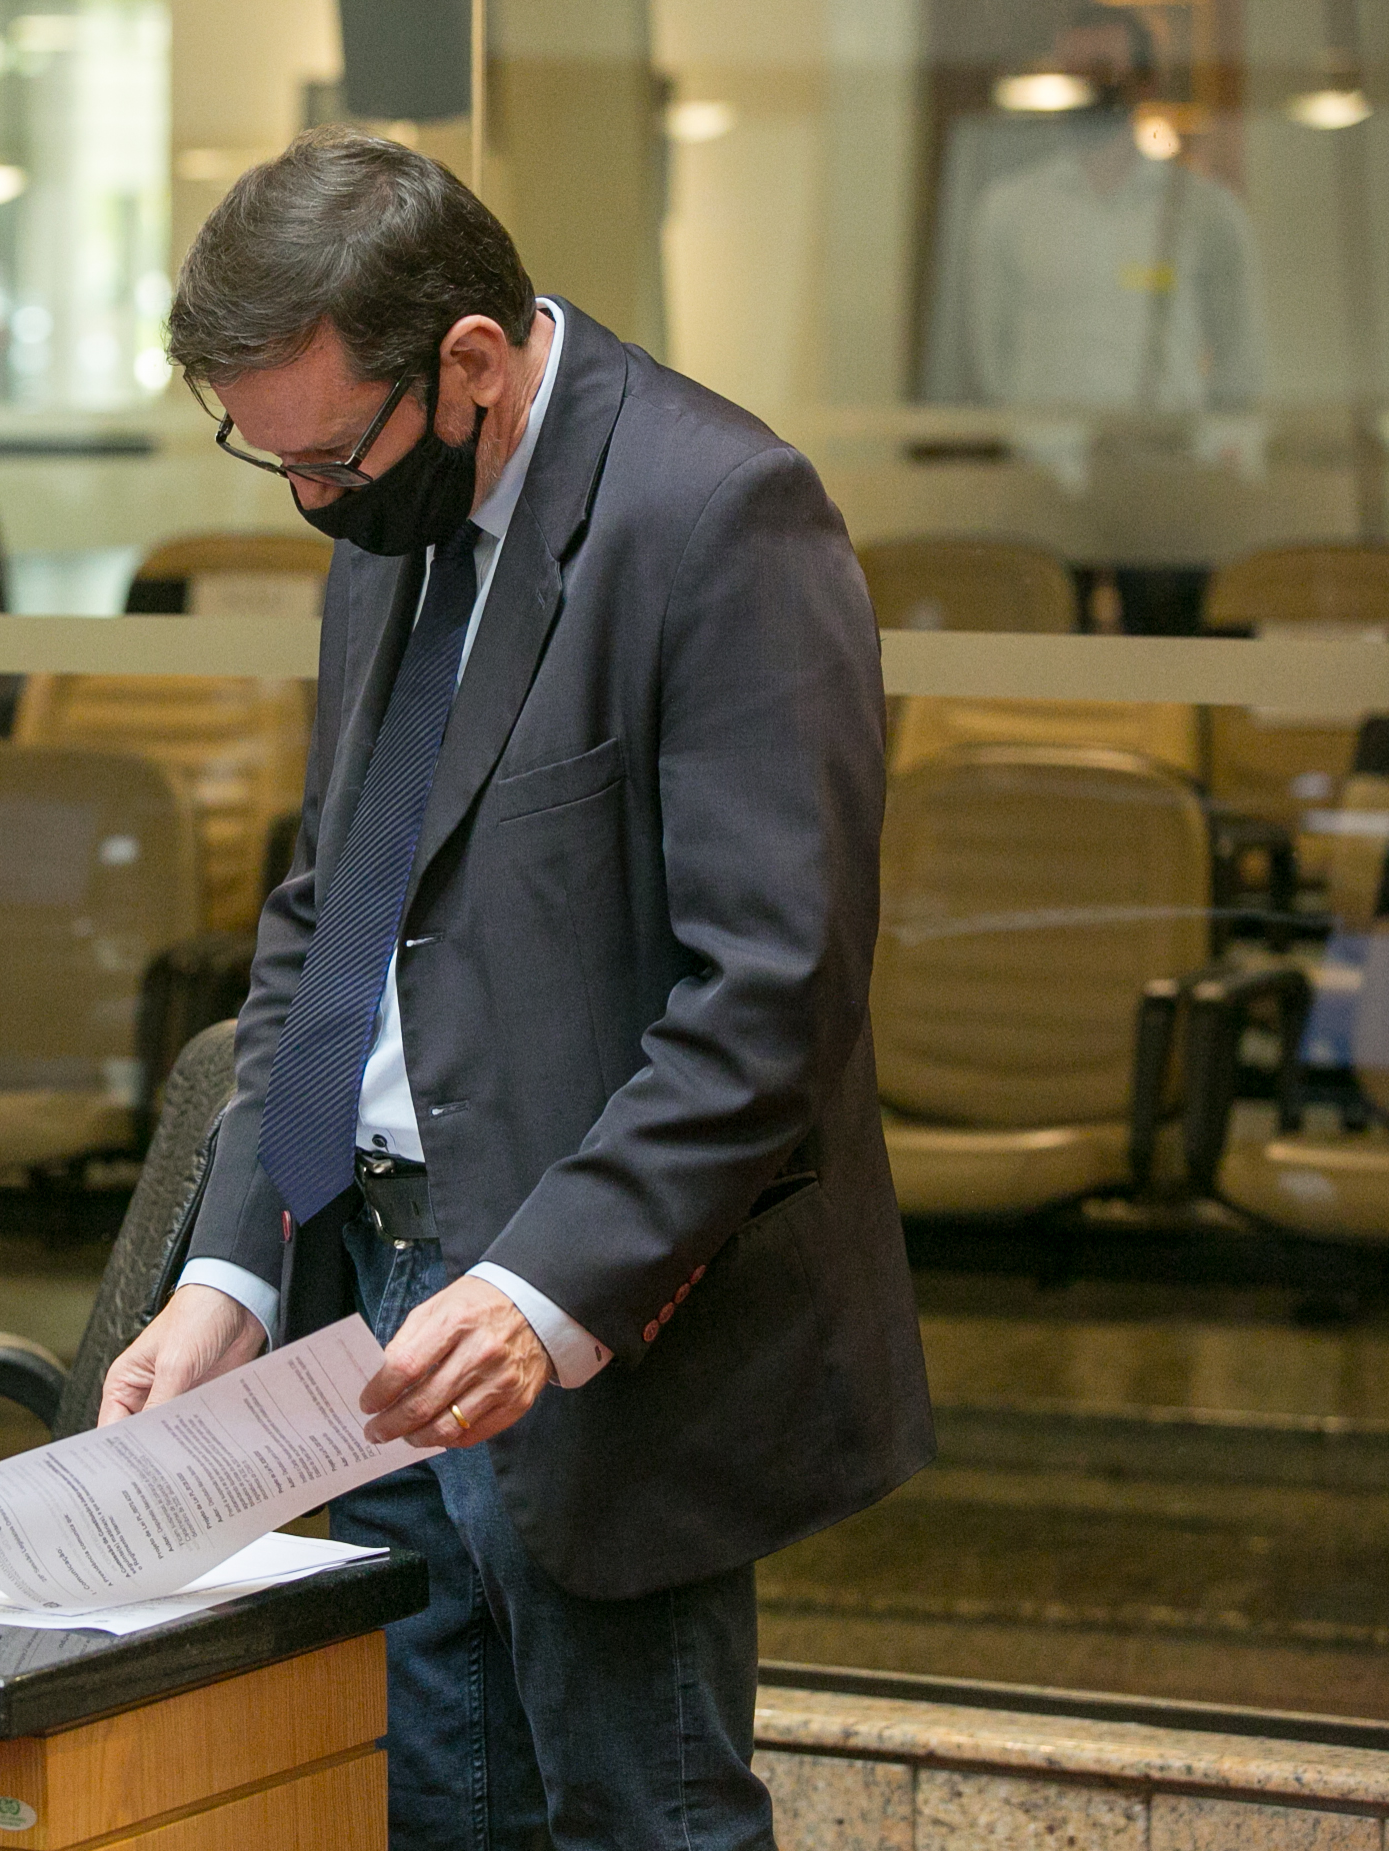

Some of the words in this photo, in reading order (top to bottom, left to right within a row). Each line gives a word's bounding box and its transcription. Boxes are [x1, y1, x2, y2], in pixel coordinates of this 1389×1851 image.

[69, 1524, 86, 1550] comunica
[118, 1534, 138, 1565] Regimento
[148, 1537, 163, 1559] Projeto
[161, 1533, 174, 1553] Autor:
[85, 1550, 108, 1582] Presidência
[105, 1543, 127, 1574] Comissão
